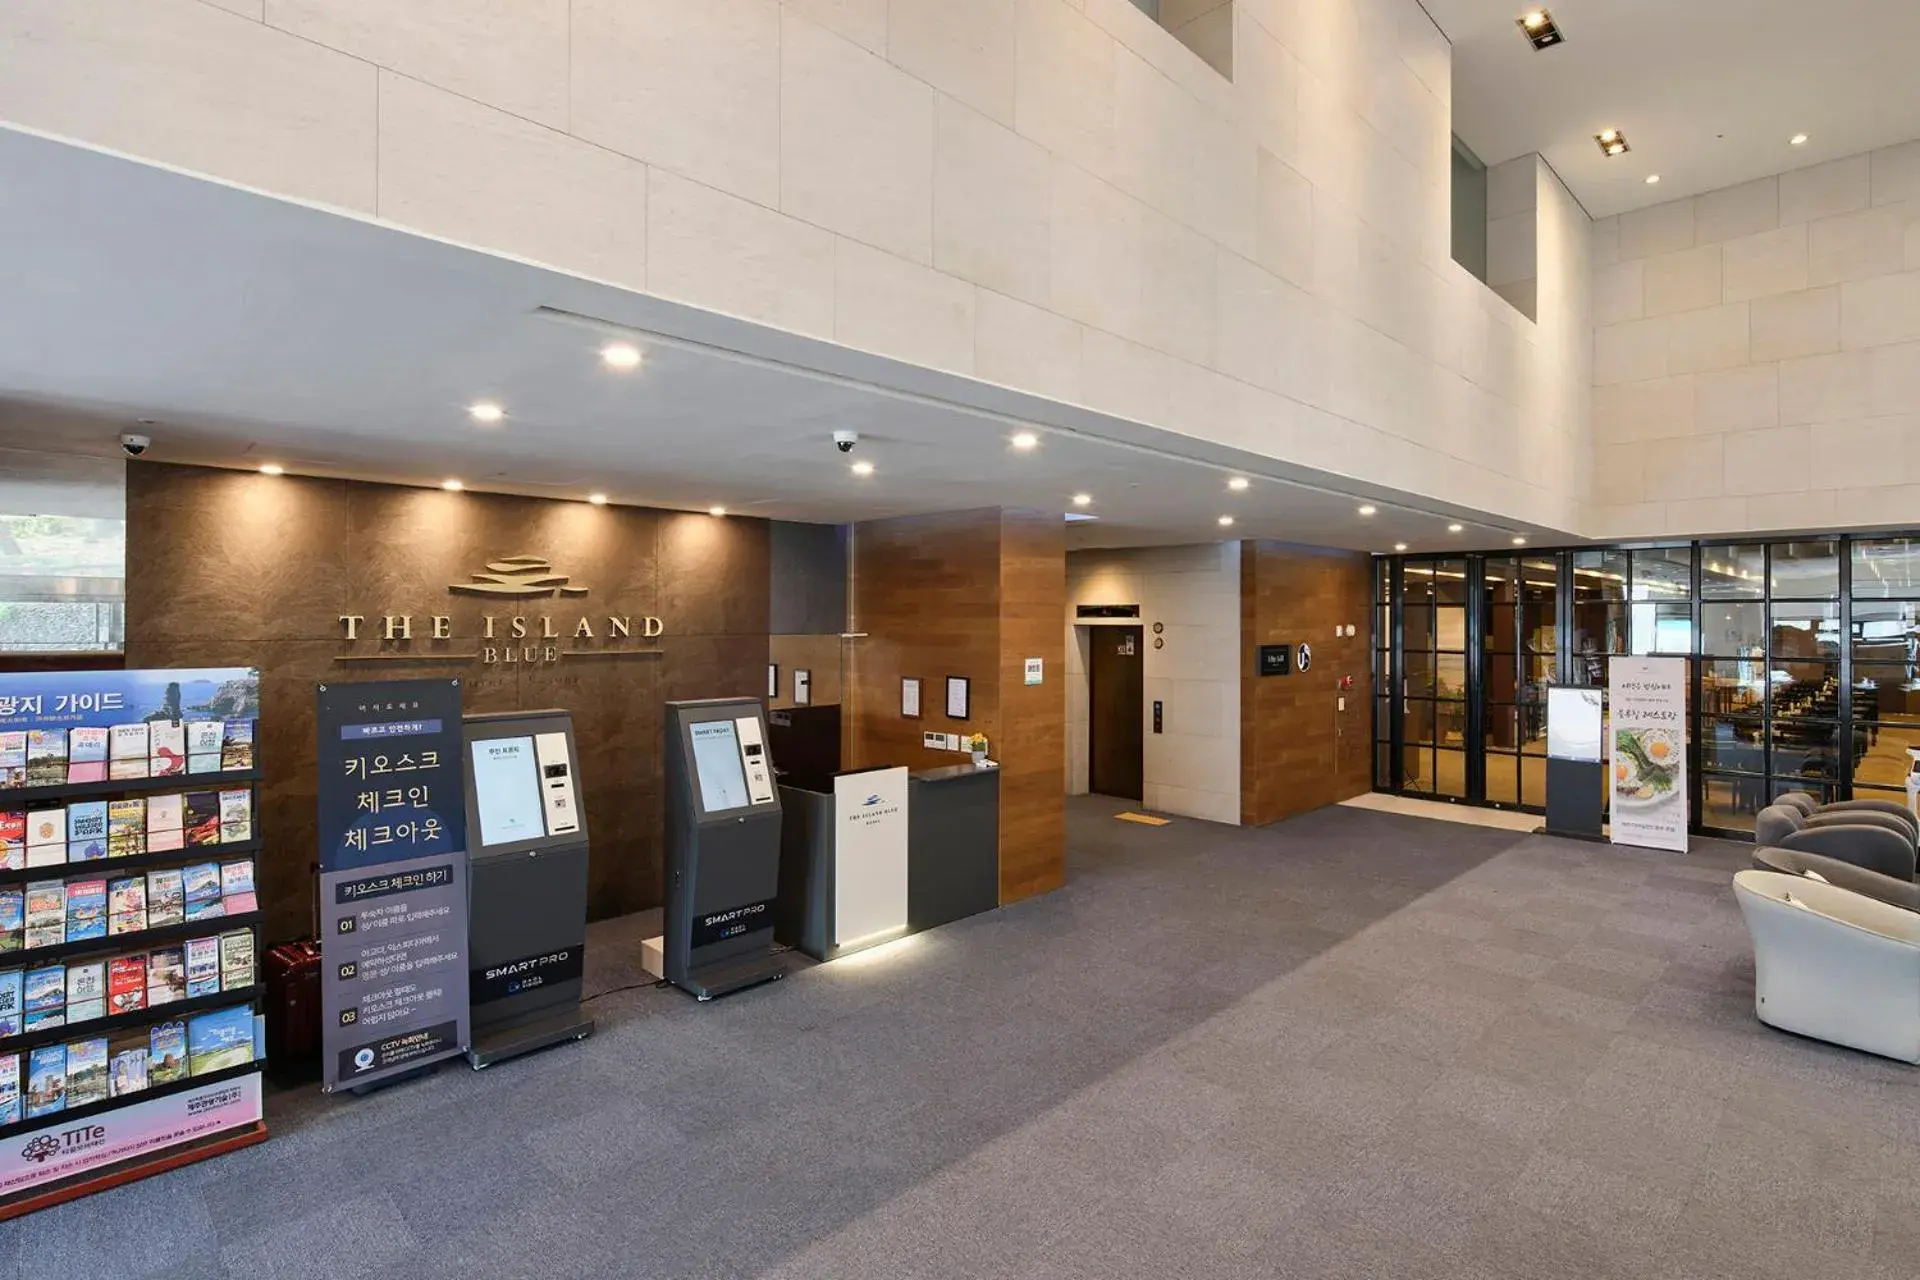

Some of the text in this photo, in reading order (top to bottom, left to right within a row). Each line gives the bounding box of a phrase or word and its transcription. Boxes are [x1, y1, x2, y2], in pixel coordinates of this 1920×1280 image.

[339, 615, 665, 640] THE ISLAND
[483, 647, 558, 663] BLUE
[55, 692, 124, 713] 가이드
[362, 725, 385, 735] 빠르고
[344, 751, 440, 781] 키오스크
[357, 786, 430, 814] 체크인
[344, 819, 442, 851] 체크아웃
[344, 880, 389, 898] 키오스크
[391, 874, 424, 889] 체크인
[340, 920, 353, 932] 01
[341, 965, 355, 976] 02
[342, 1011, 355, 1023] 03
[380, 1039, 402, 1051] CCTV
[61, 1124, 105, 1146] TiTe
